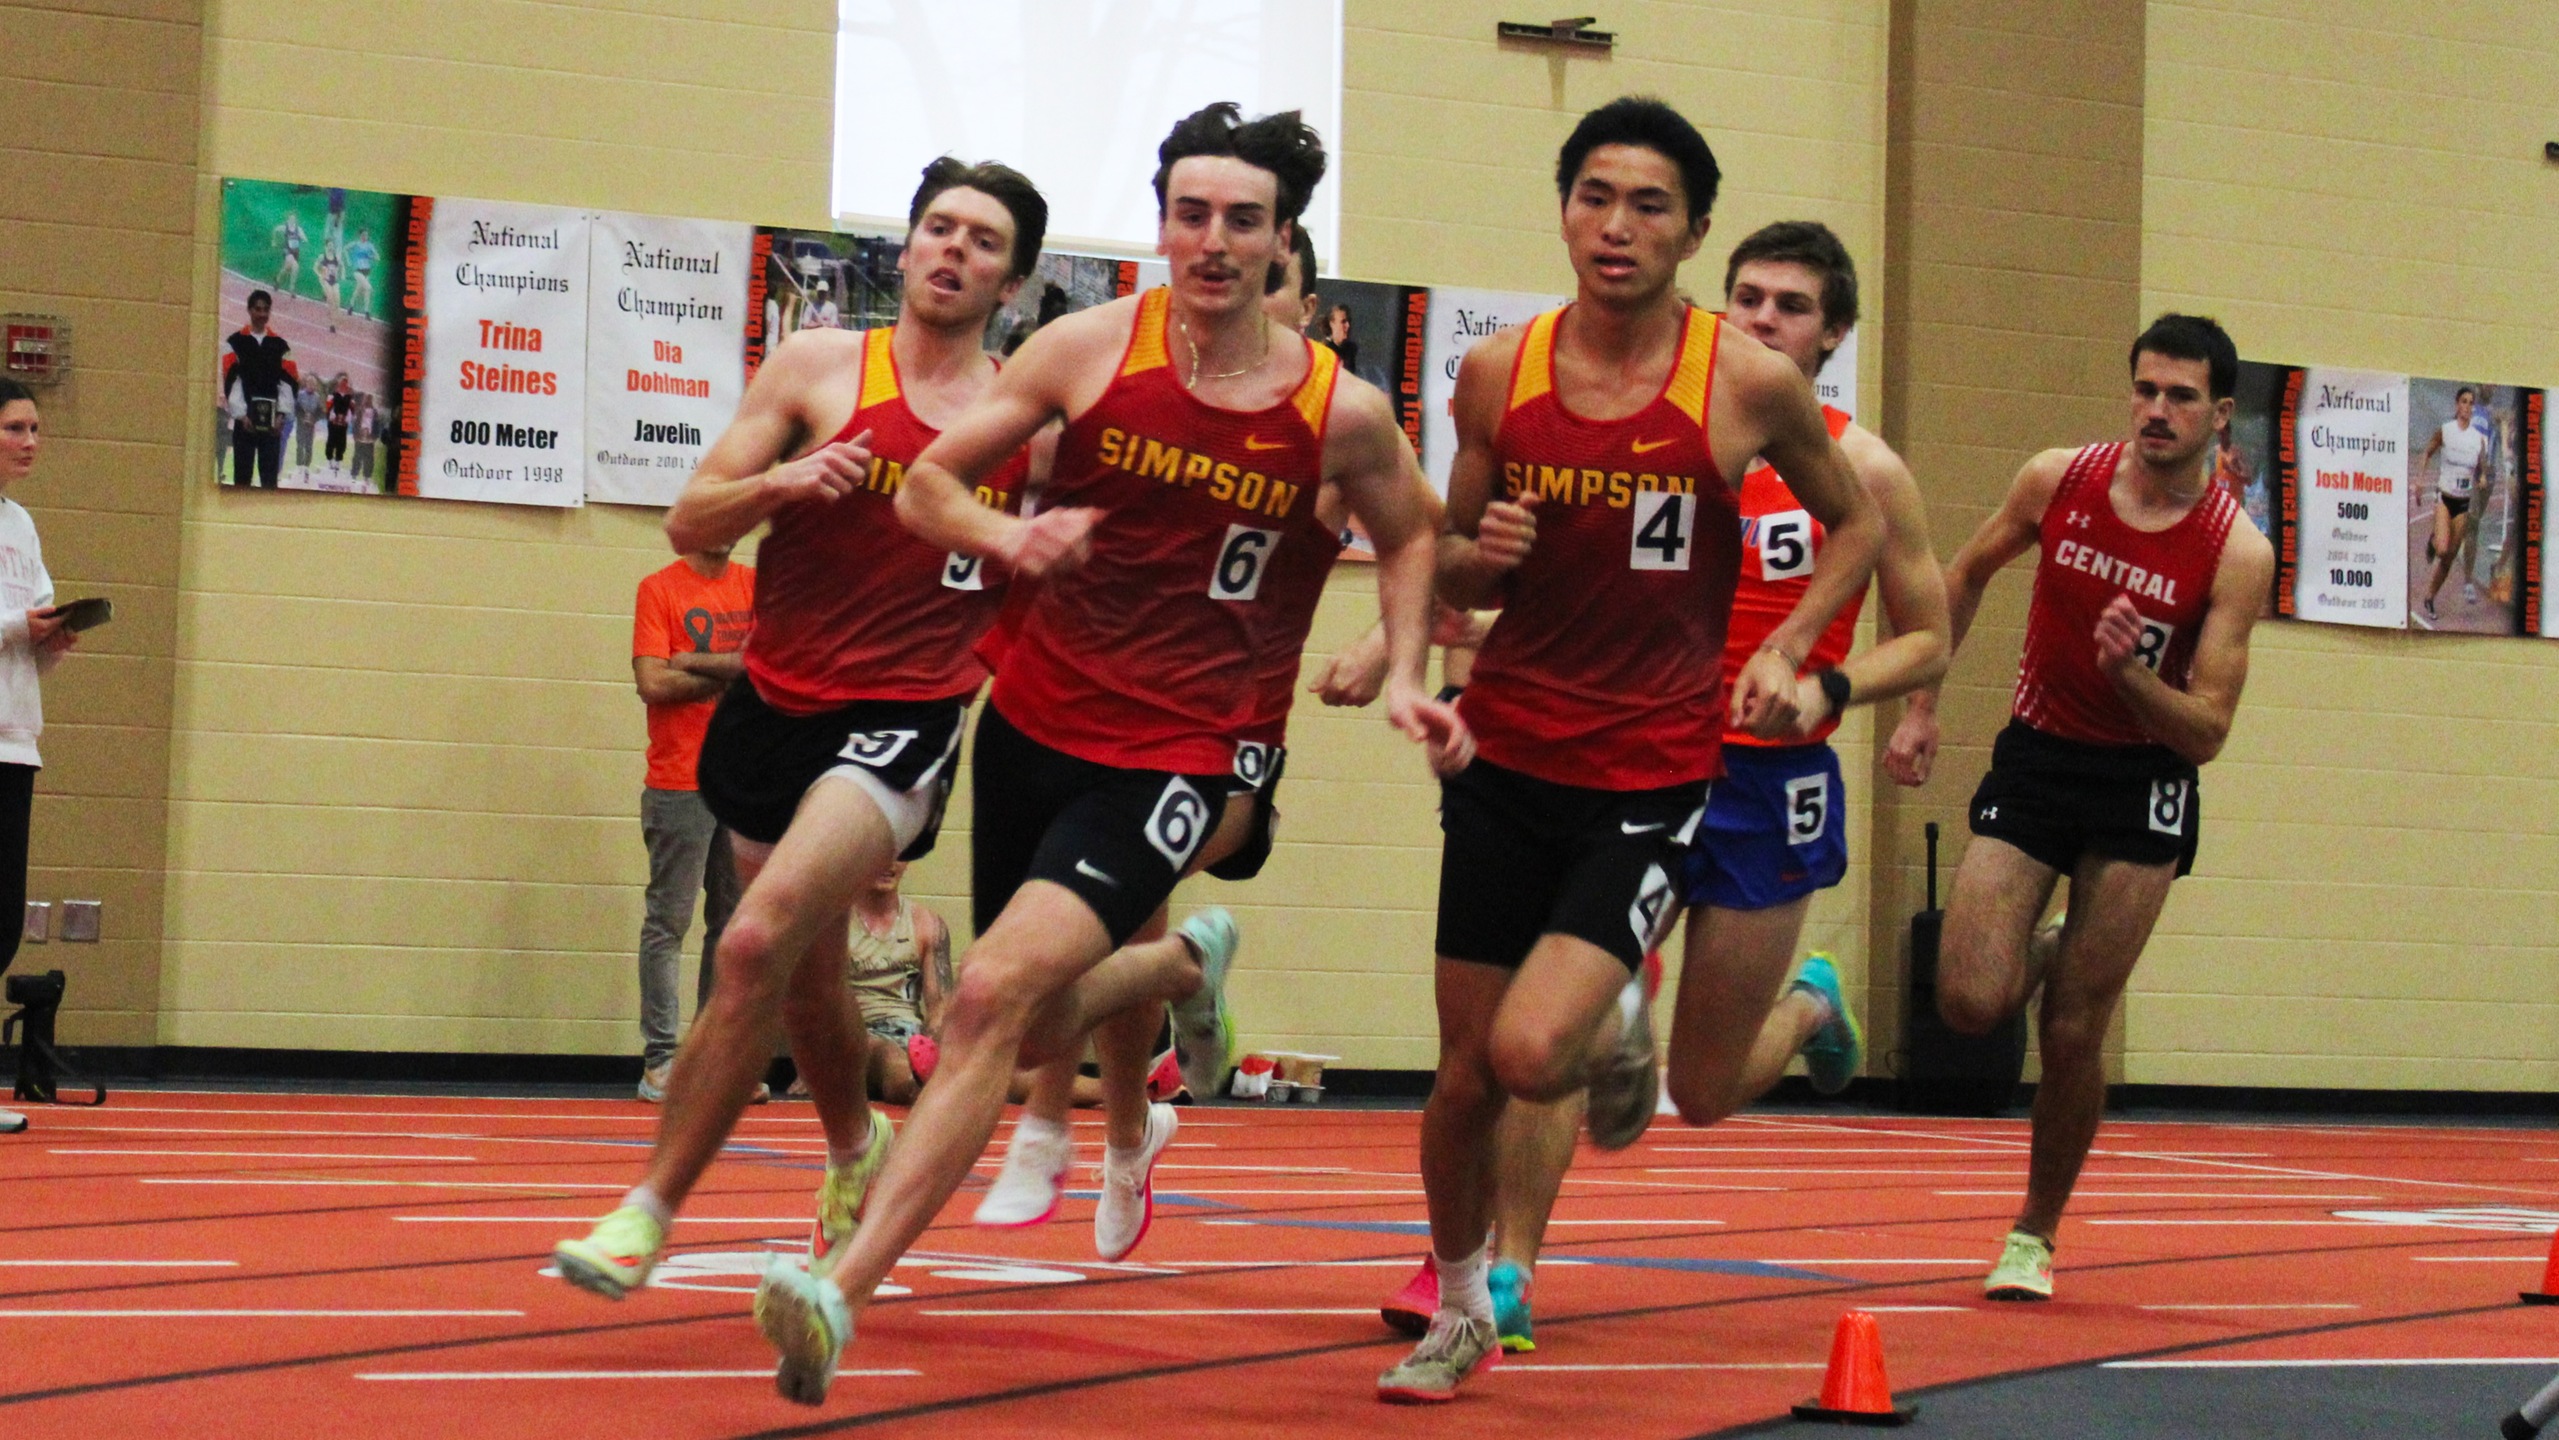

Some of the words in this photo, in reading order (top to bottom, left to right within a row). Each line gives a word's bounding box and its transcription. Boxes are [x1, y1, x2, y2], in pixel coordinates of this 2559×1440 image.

[467, 220, 559, 253] National
[622, 240, 720, 275] National
[456, 262, 569, 296] Champions
[617, 287, 723, 326] Champion
[479, 319, 542, 352] Trina
[1401, 293, 1428, 394] Wartburg
[1452, 308, 1515, 344] Nati
[404, 314, 428, 381] Track
[653, 340, 682, 364] Dia
[743, 343, 765, 383] Tra
[460, 360, 557, 396] Steines
[626, 369, 710, 398] Dohlman
[2316, 384, 2391, 413] National
[450, 420, 491, 445] 800
[495, 423, 559, 449] Meter
[634, 419, 701, 446] Javelin
[2311, 426, 2396, 457] Champion
[443, 458, 513, 481] Outdoor
[523, 465, 563, 484] 1998
[597, 450, 650, 467] Outdoor
[1100, 427, 1299, 518] SIMPSON
[2315, 469, 2349, 490] Josh
[2352, 471, 2393, 494] Moen
[1635, 494, 1686, 563] 4
[2337, 502, 2369, 520] 5000
[1218, 531, 1266, 594] 6
[1767, 522, 1804, 571] 5
[2054, 539, 2178, 606] CENTRAL
[1794, 786, 1823, 835] 5
[2154, 777, 2181, 827] 8
[1158, 790, 1200, 853] 6
